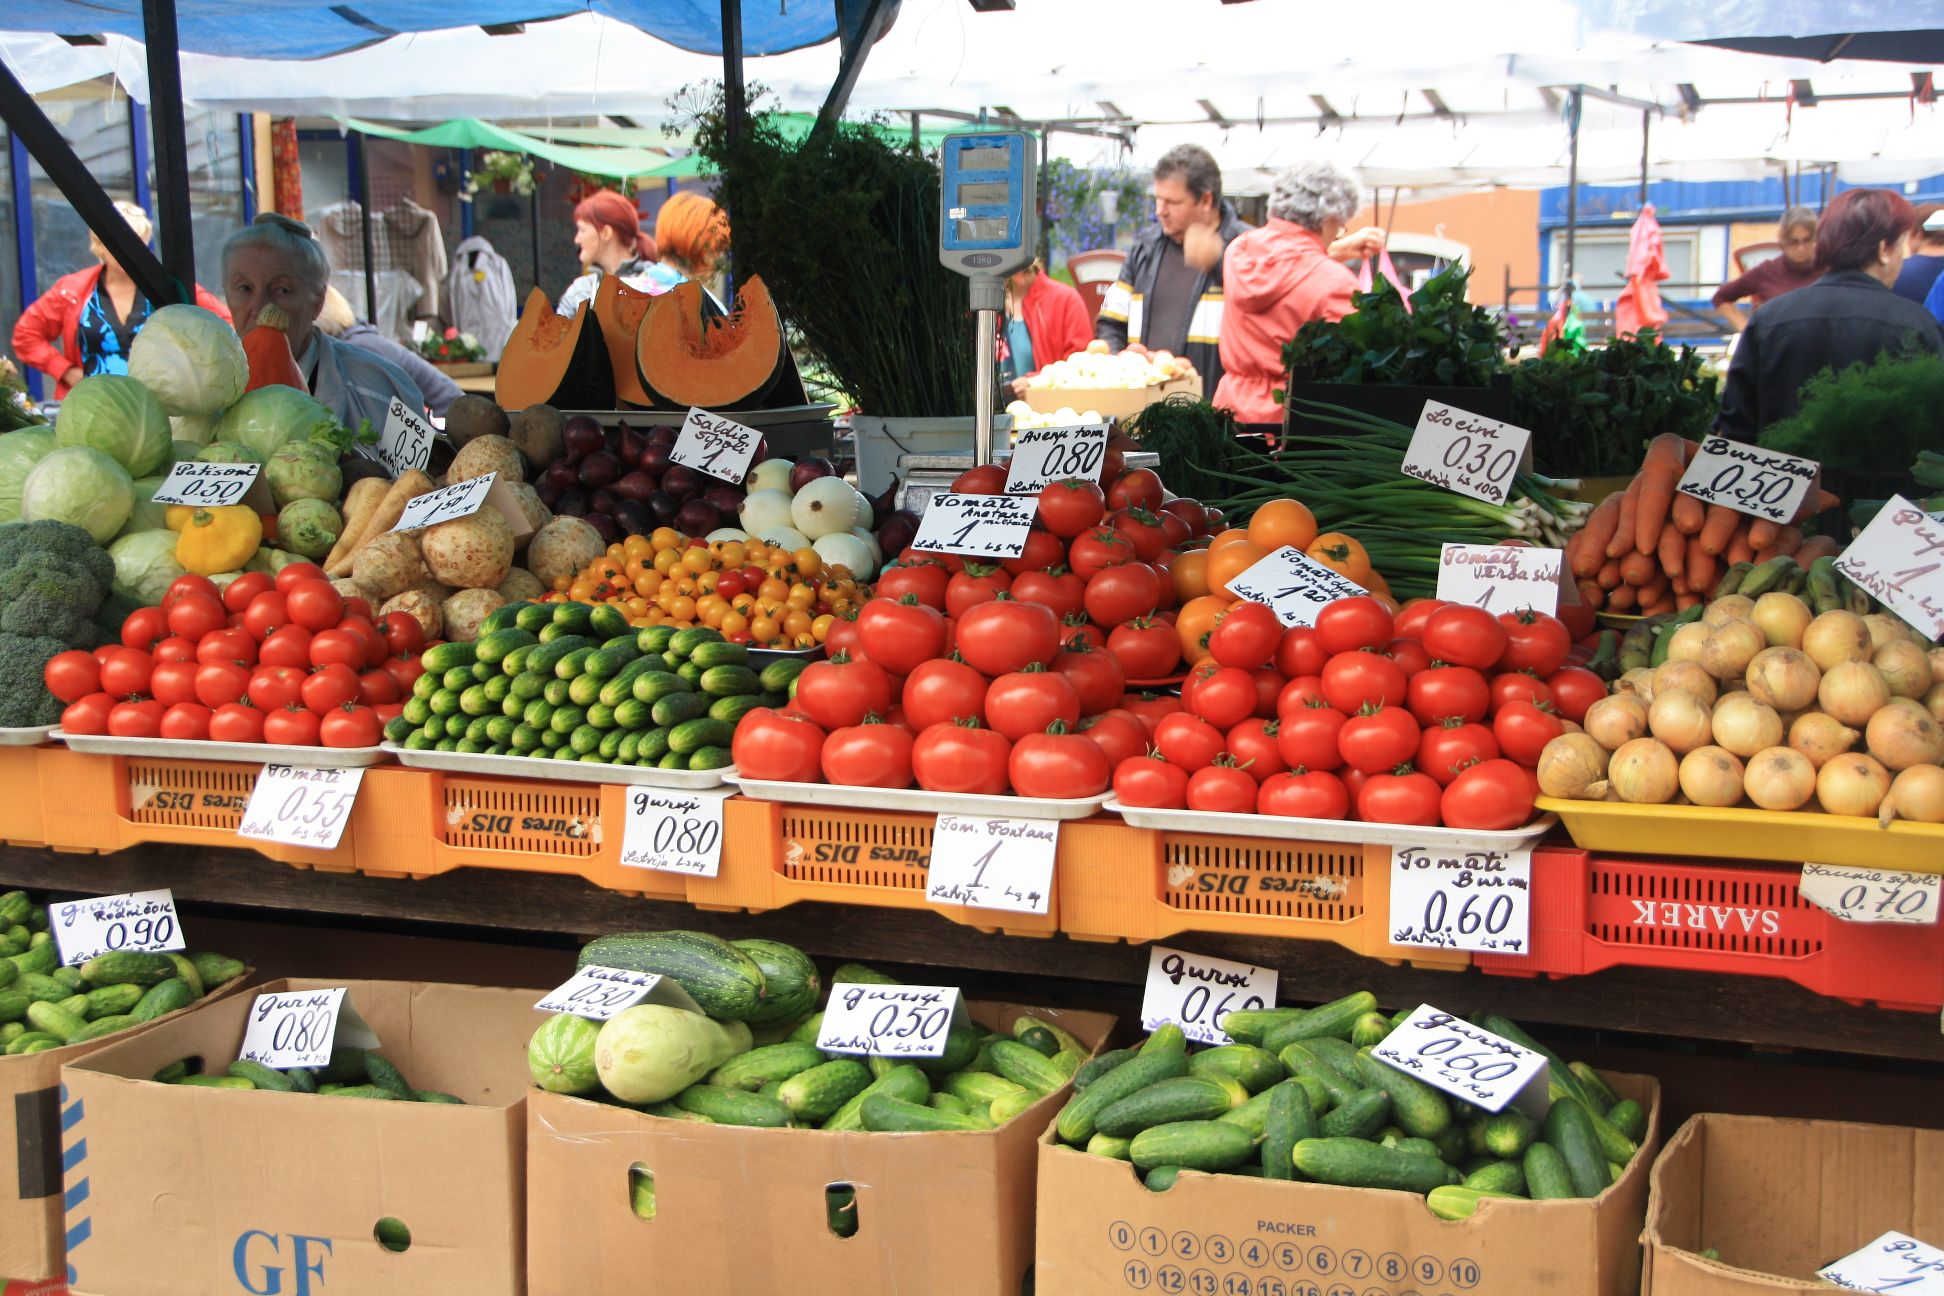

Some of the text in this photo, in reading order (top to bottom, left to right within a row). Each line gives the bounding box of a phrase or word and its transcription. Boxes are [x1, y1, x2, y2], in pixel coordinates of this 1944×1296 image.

[391, 403, 426, 439] Bietes
[1041, 441, 1104, 477] 0.80
[1443, 435, 1516, 482] 0.30
[181, 479, 244, 498] 0.50
[1711, 464, 1794, 504] 0.50
[278, 786, 356, 828] 0.55
[653, 816, 719, 855] 0.80
[1424, 889, 1514, 934] 0.60
[1631, 900, 1779, 934] SAAREK
[1840, 885, 1927, 914] 0.70
[106, 915, 174, 950] 0.90
[568, 983, 636, 1007] 0.30
[273, 1010, 332, 1052] 0.80
[869, 1004, 950, 1040] 0.50
[1417, 1037, 1518, 1081] 0.60
[1257, 1220, 1317, 1238] PACKER
[233, 1229, 333, 1296] GF
[1117, 1228, 1477, 1283] 0 1 2 3 4 5 6 7 8 9 10
[1128, 1265, 1147, 1284] 11
[1159, 1271, 1182, 1289] 12
[1192, 1275, 1215, 1293] 13
[1225, 1279, 1249, 1295] 14
[1259, 1282, 1283, 1296] 15
